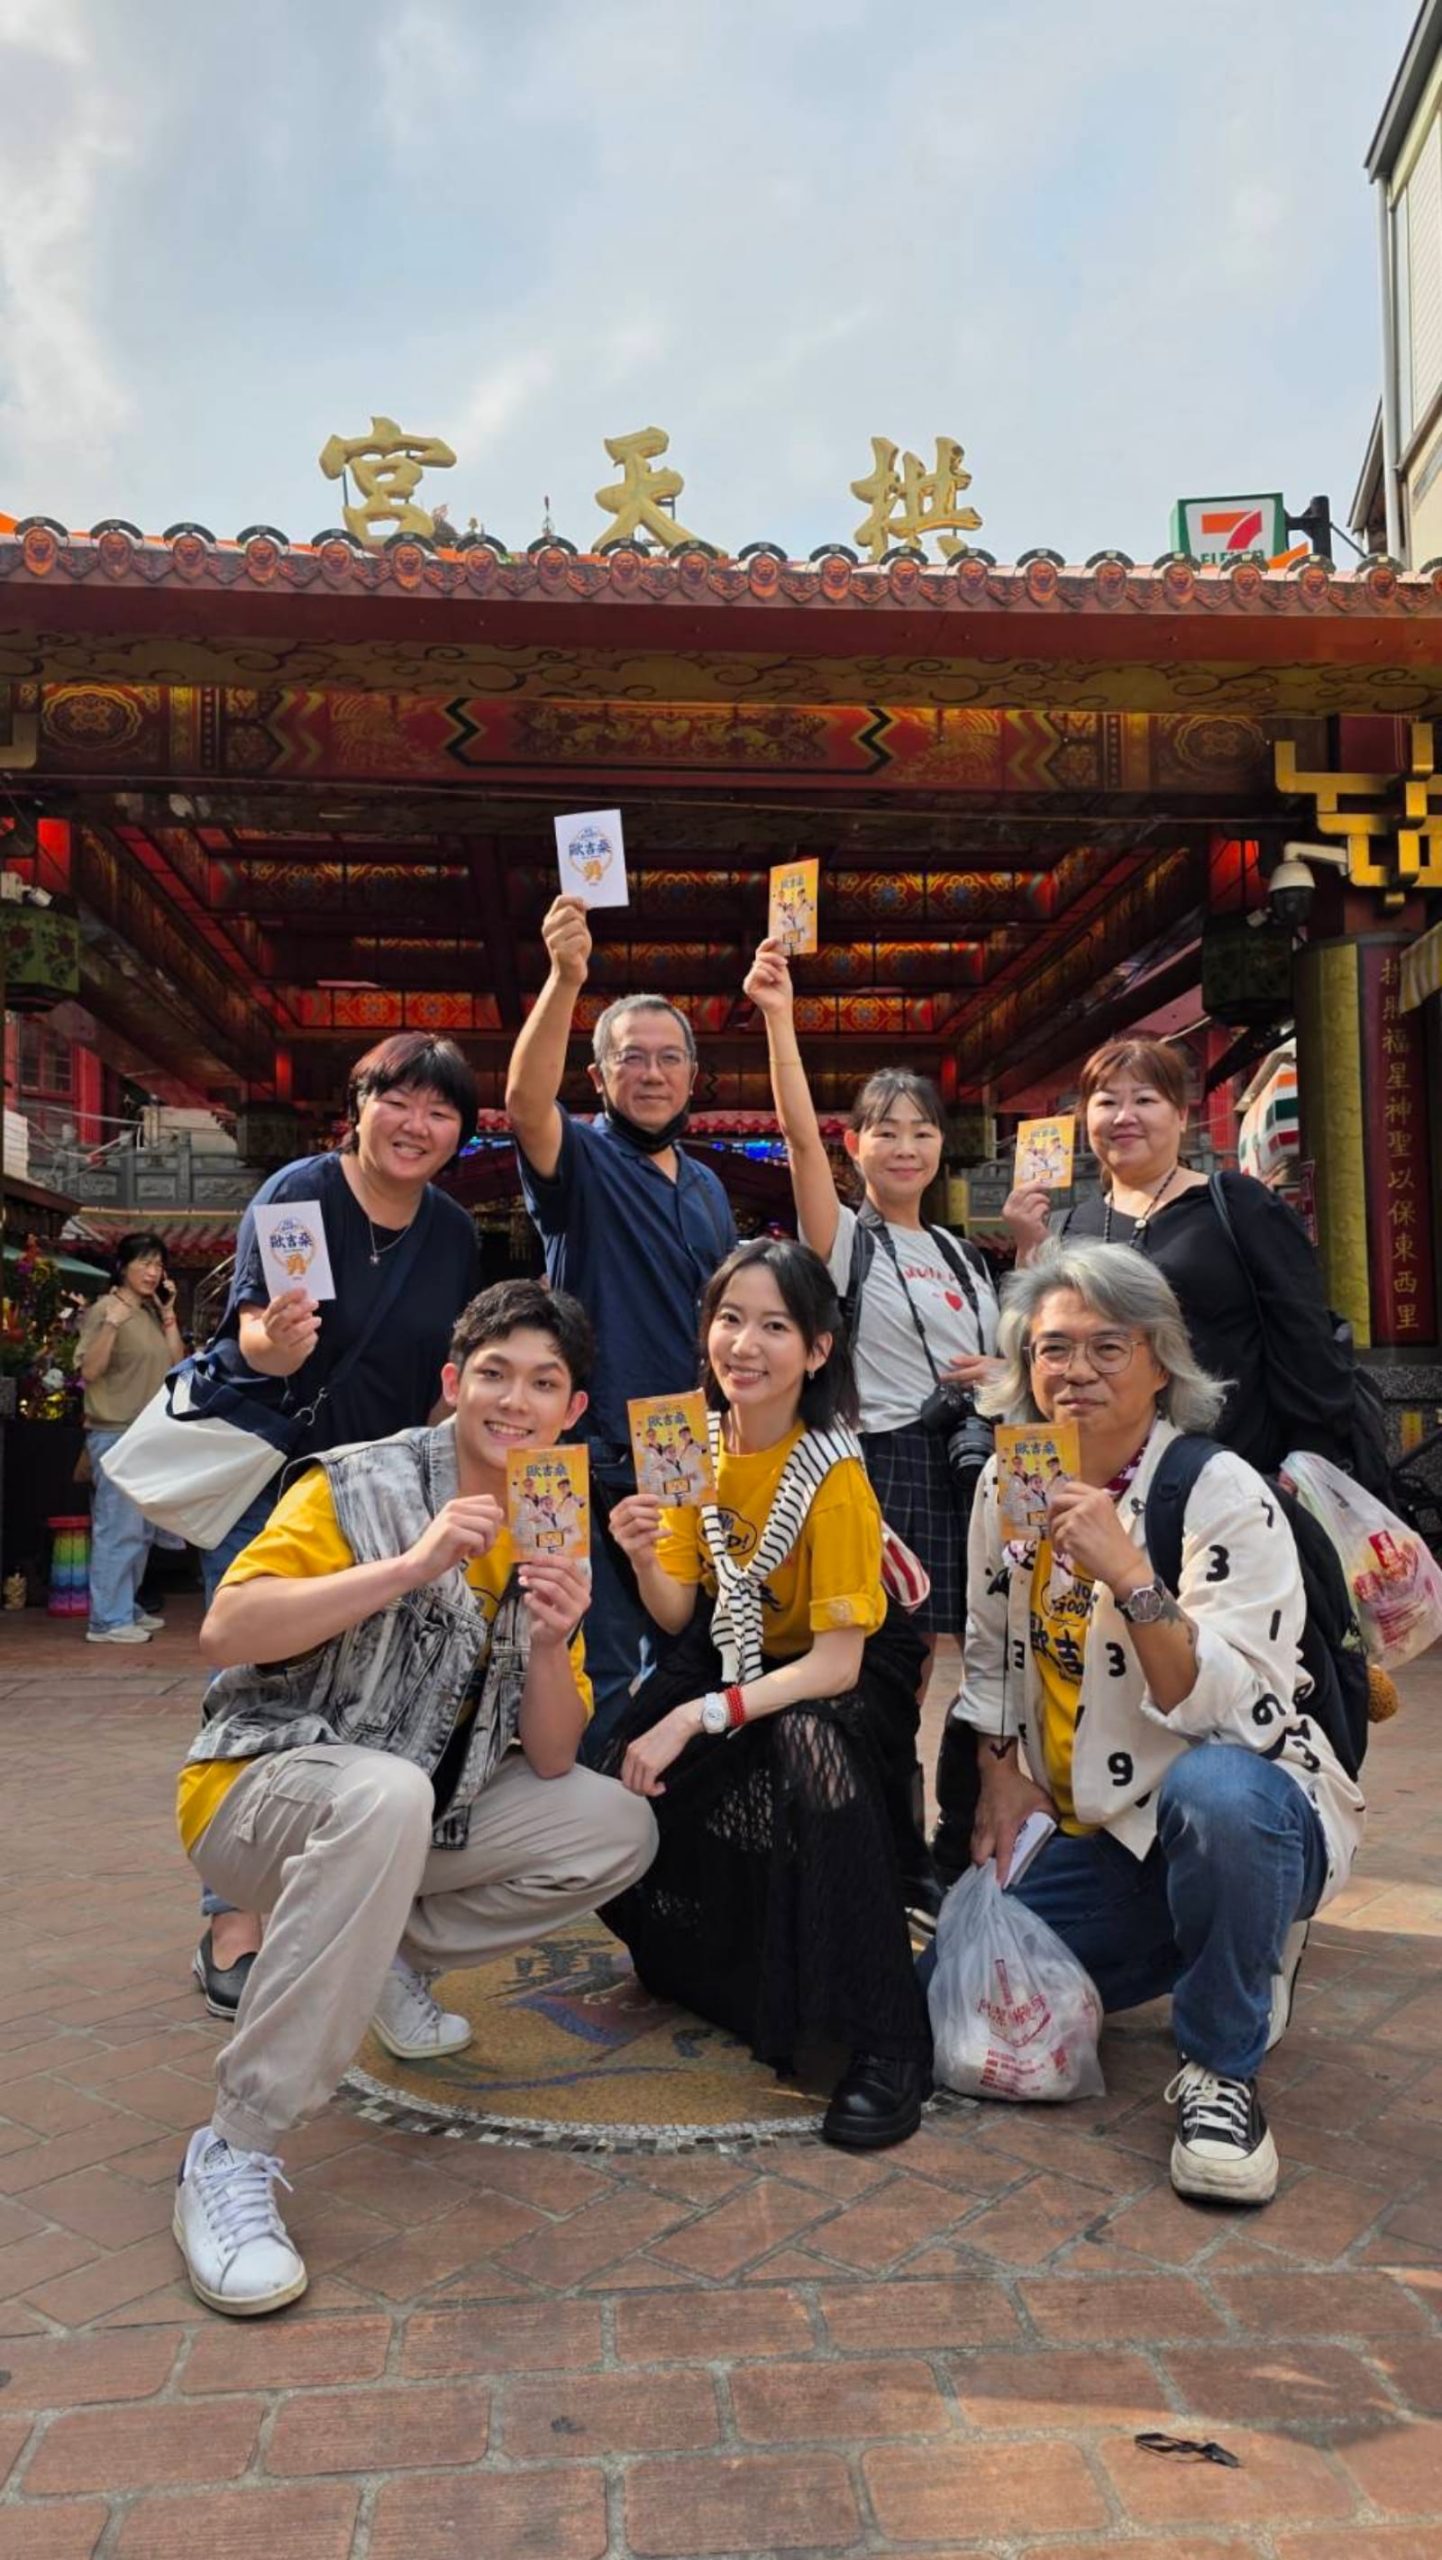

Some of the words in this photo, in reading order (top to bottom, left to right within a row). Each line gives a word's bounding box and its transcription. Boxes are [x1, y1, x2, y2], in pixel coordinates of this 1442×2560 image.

[1206, 1545, 1229, 1581] 3
[1105, 1642, 1126, 1677] 3
[1108, 1752, 1133, 1786] 9
